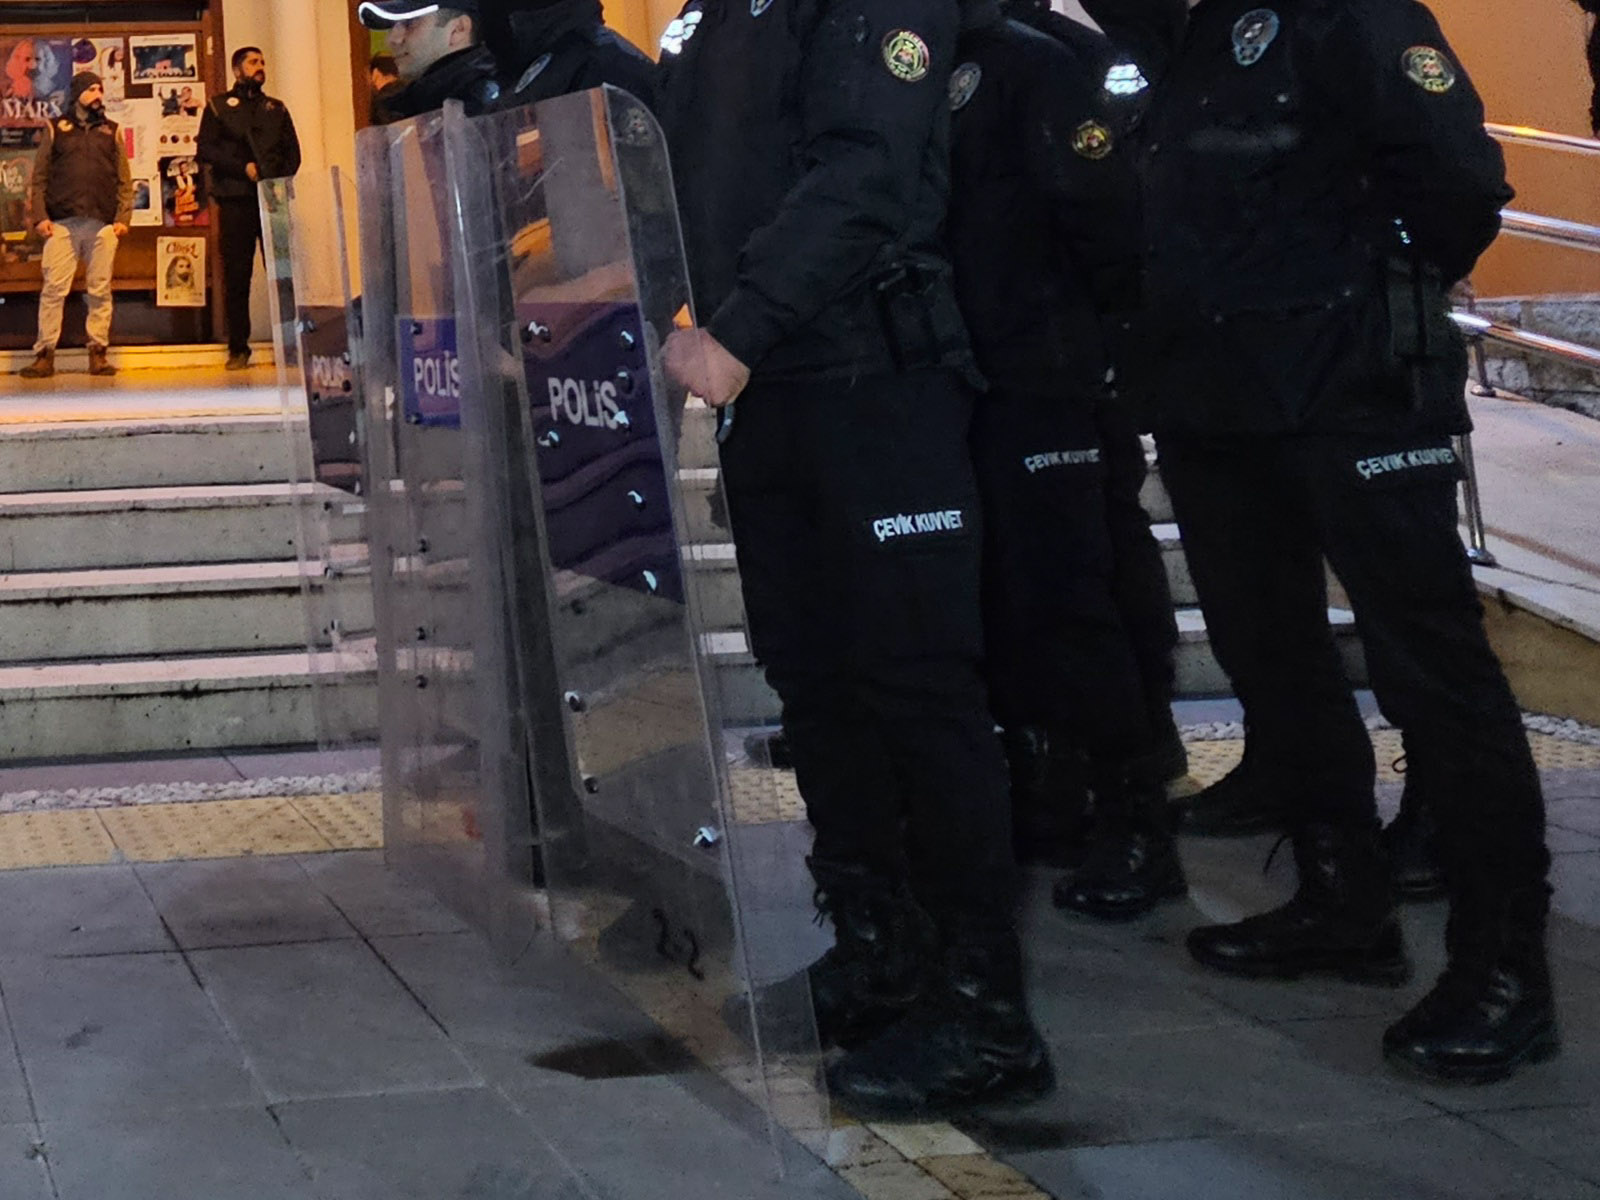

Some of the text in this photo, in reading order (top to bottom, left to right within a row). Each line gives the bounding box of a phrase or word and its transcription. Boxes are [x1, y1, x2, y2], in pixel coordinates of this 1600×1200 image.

[1, 98, 62, 119] MARX
[547, 377, 619, 430] POLİS
[915, 510, 963, 533] KUVVET
